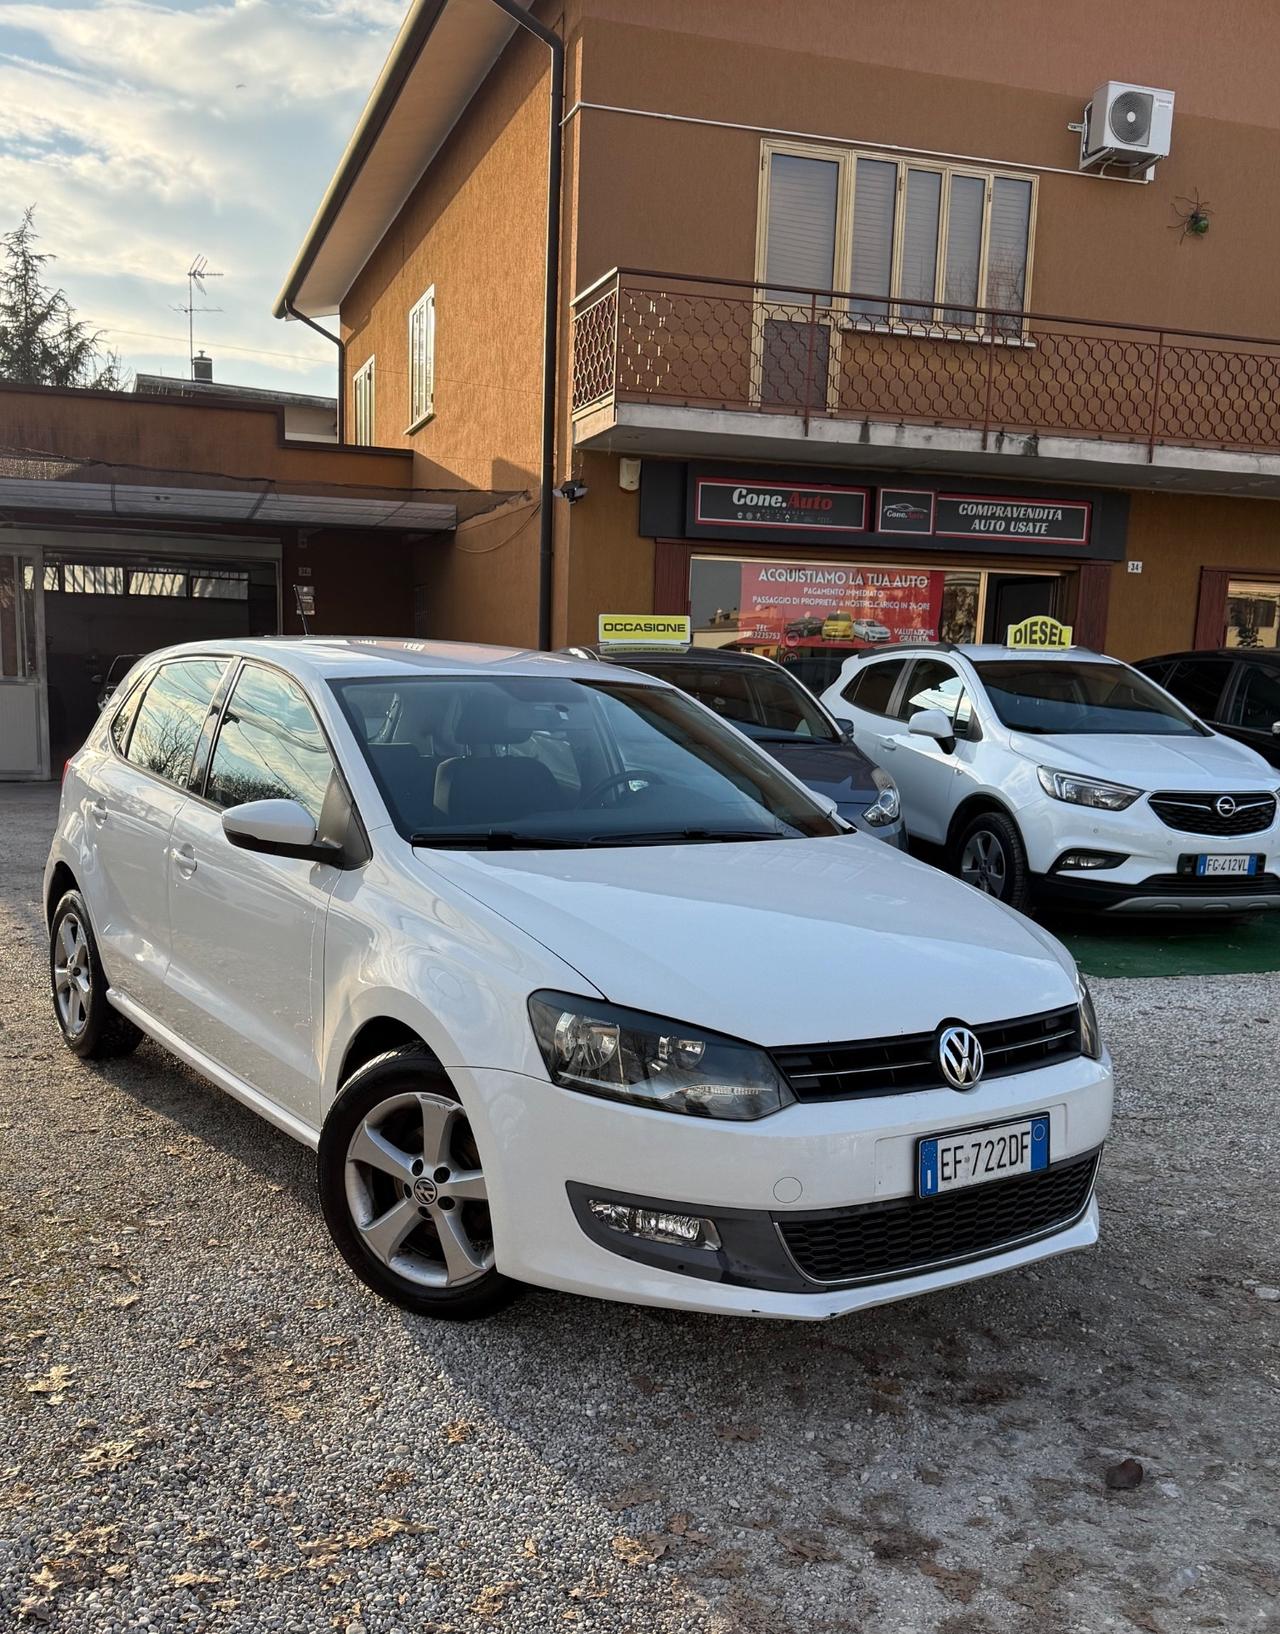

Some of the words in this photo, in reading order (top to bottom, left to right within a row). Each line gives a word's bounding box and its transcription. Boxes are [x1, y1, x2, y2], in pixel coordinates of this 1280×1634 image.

[732, 487, 833, 510] Cone.Auto
[958, 503, 1063, 521] COMPRAVENDITA
[970, 519, 1006, 532] AUTO
[1009, 521, 1049, 534] USATE
[1130, 563, 1139, 571] 34
[758, 568, 846, 585] ACQUISTIAMO
[849, 573, 864, 586] LA
[867, 573, 891, 587] TUA
[894, 575, 928, 588] AUTO
[803, 586, 845, 597] PAGAMENTO
[752, 596, 792, 605] PASSAGGIO
[603, 622, 686, 632] OCCASIONE
[1013, 620, 1066, 646] DIESEL
[1206, 859, 1219, 872] FG
[1220, 858, 1247, 872] 412VL
[940, 1145, 964, 1181] EF
[971, 1131, 1031, 1176] 722DF
